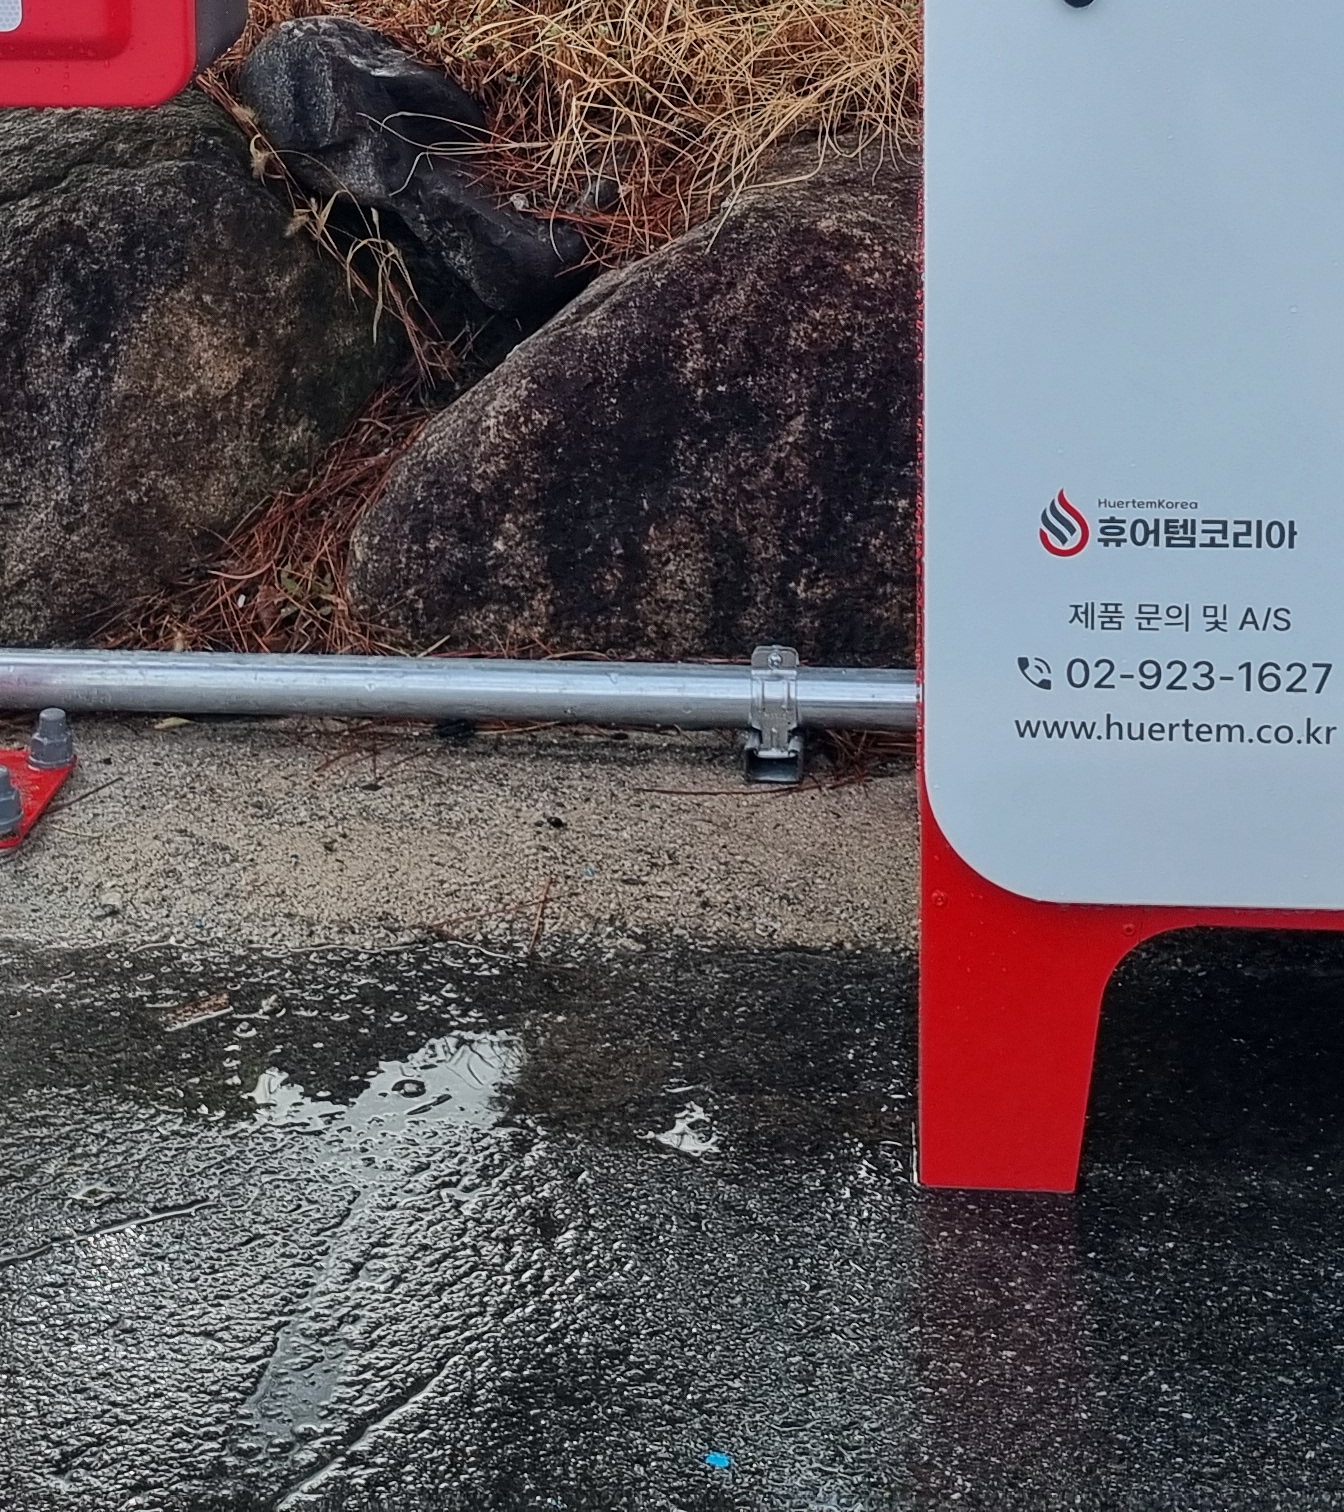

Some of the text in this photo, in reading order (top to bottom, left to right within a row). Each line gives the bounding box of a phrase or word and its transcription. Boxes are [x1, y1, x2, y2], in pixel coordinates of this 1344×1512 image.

[1097, 497, 1199, 510] HuertemKorea
[1096, 516, 1299, 550] 휴어템코리아
[1068, 601, 1293, 633] 제품 문의 및 A/S
[1065, 657, 1334, 695] 02-923-1627
[1014, 713, 1338, 746] www.huertem.co.kr
